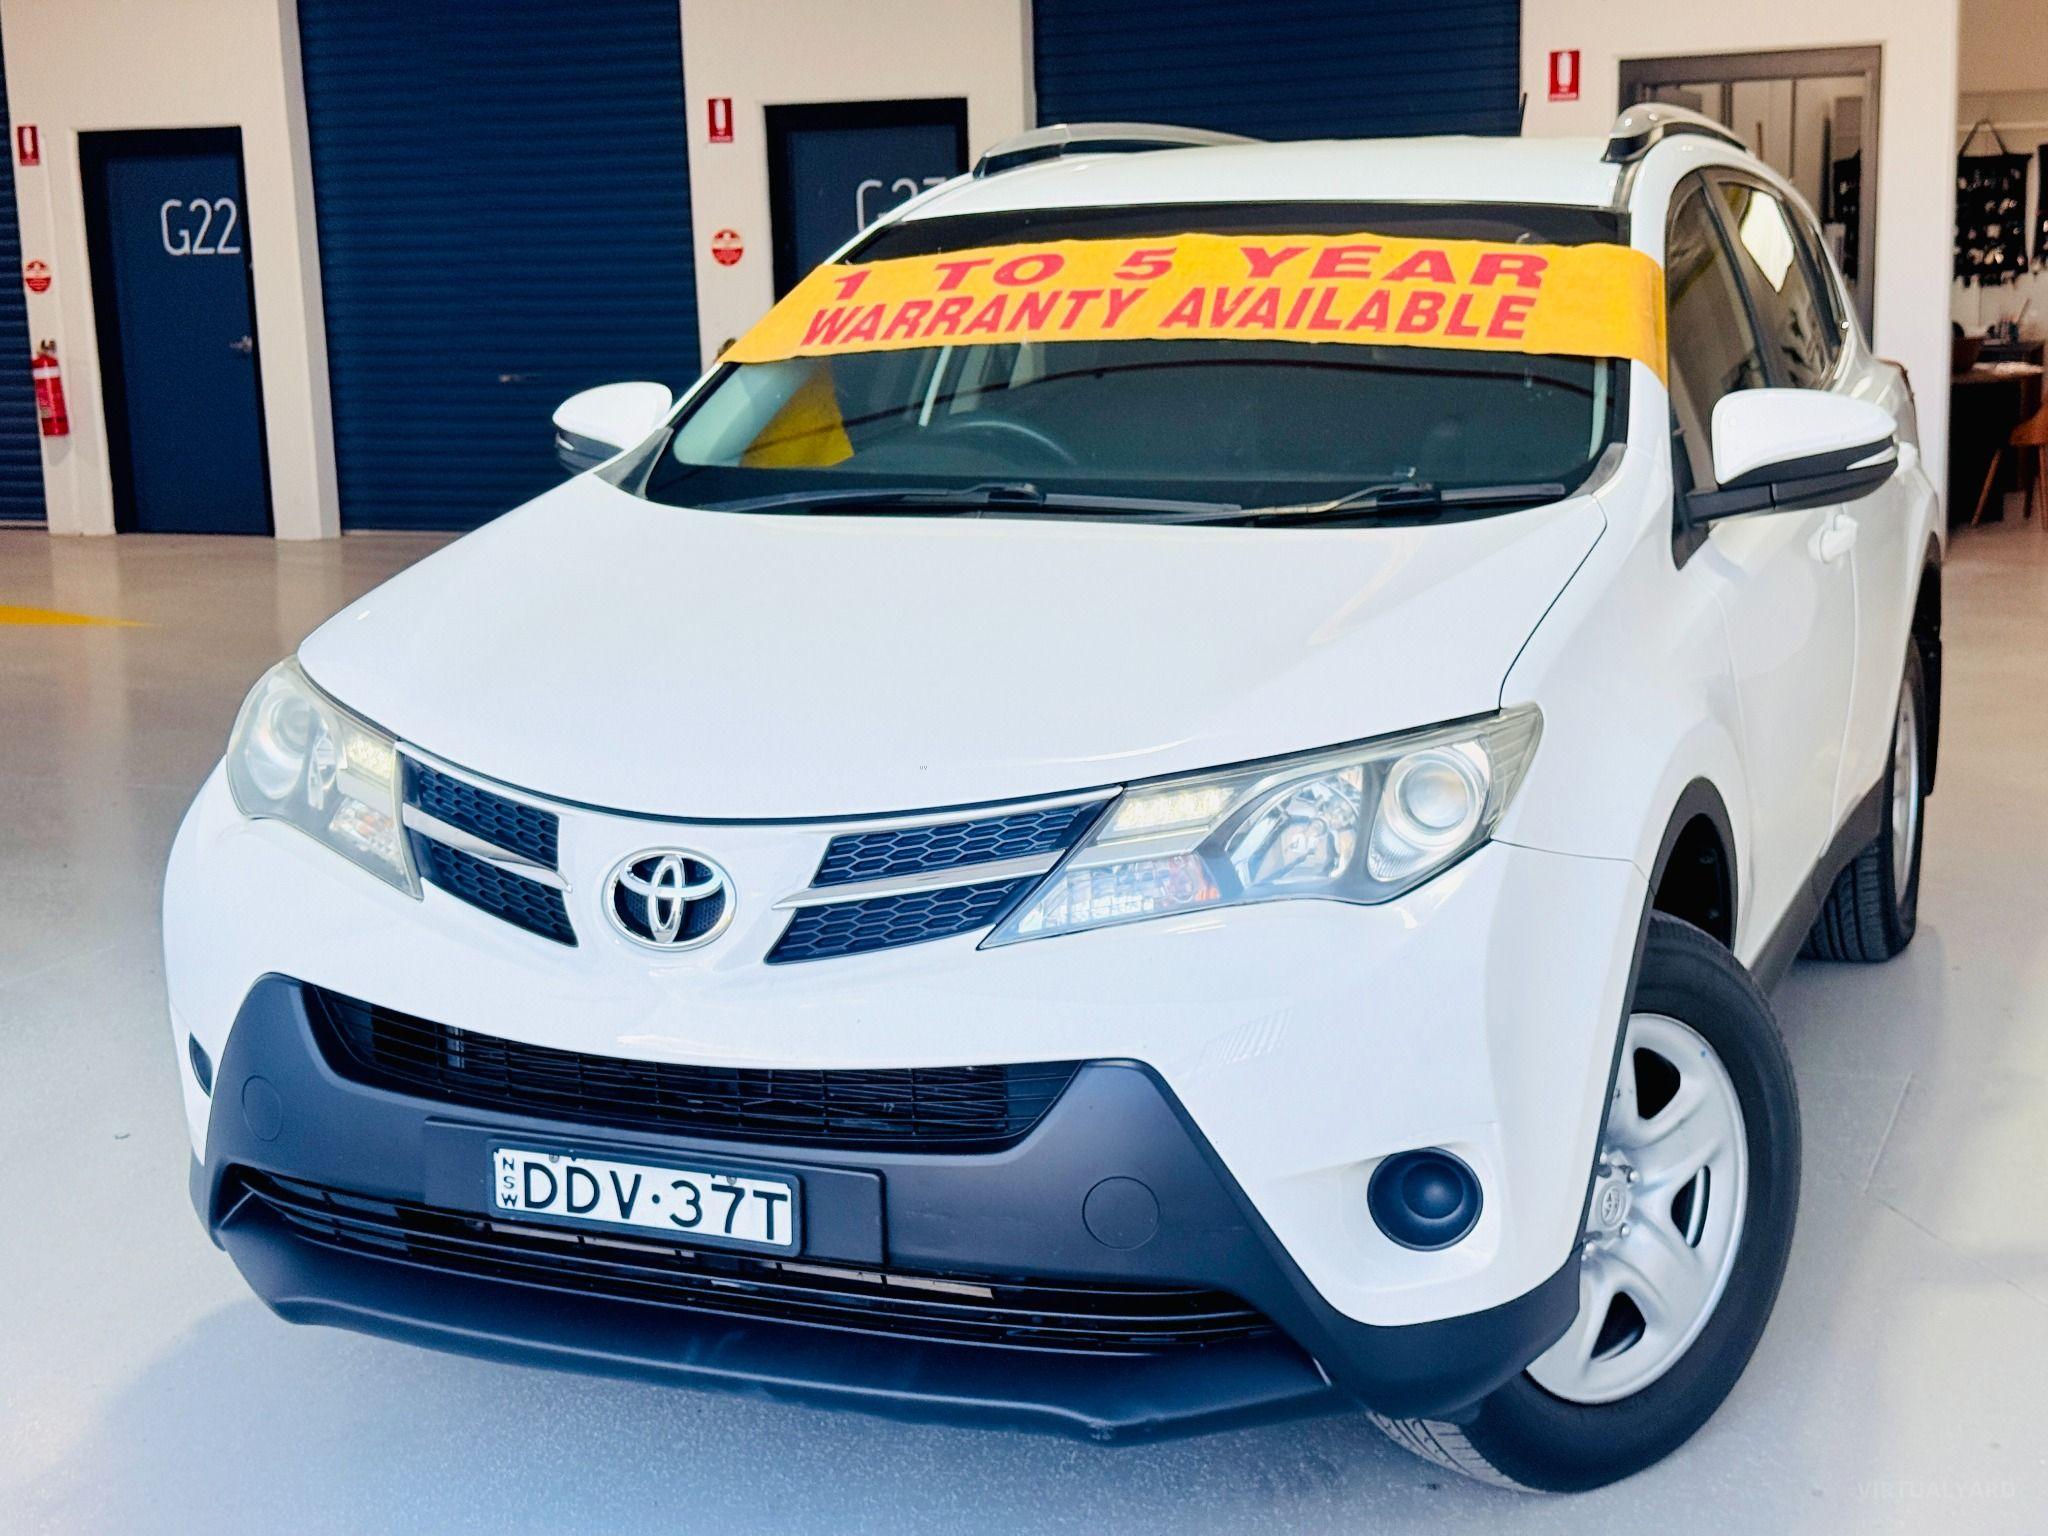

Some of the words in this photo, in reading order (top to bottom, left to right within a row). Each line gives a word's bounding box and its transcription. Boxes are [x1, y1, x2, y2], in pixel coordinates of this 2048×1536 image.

[161, 198, 240, 255] G22
[834, 270, 871, 300] 1
[935, 253, 1065, 291] TO
[1113, 247, 1177, 281] 5
[1240, 245, 1549, 289] YEAR
[800, 287, 1148, 346] WARRANTY
[1158, 287, 1537, 340] AVAILABLE
[502, 1157, 518, 1207] NSW
